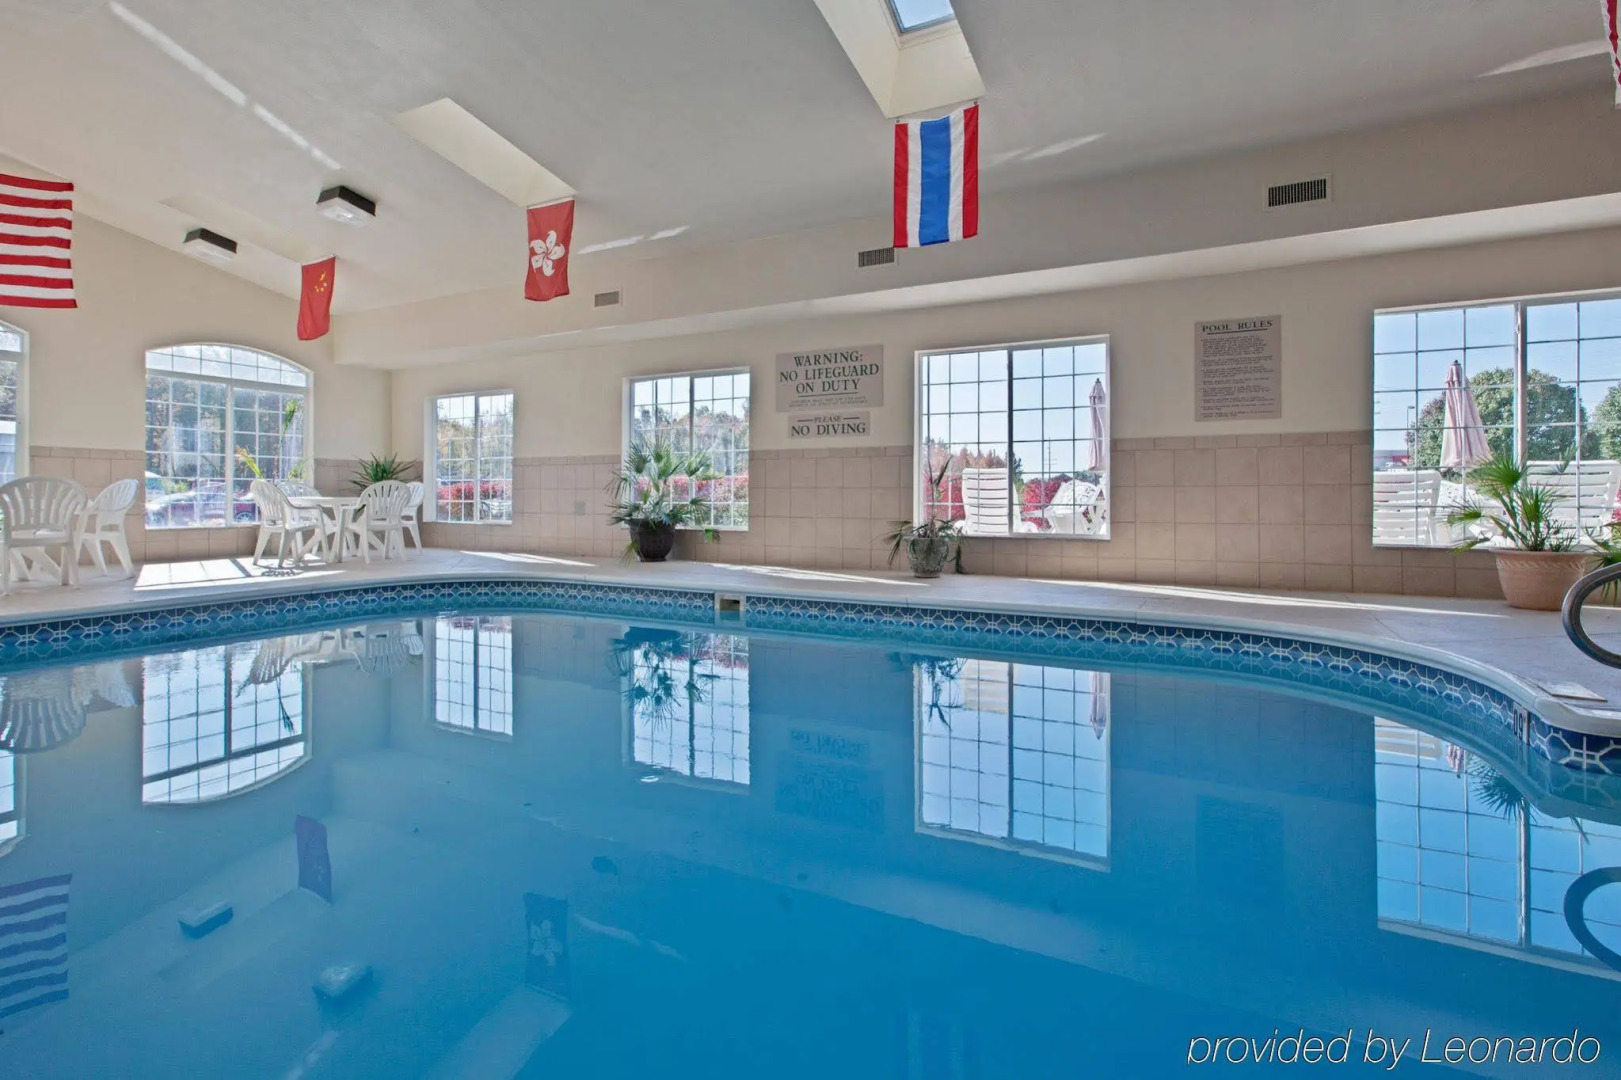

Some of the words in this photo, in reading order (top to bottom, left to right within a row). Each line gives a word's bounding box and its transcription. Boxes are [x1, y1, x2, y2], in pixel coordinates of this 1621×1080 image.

[1202, 324, 1231, 332] POOL
[1238, 320, 1272, 329] RULES
[794, 350, 863, 367] WARNING:
[780, 370, 798, 382] NO
[805, 363, 879, 380] LIFEGUARD
[796, 382, 814, 394] ON
[822, 378, 860, 392] DUTY
[814, 415, 841, 423] PLEASE
[791, 425, 810, 436] NO
[817, 423, 866, 435] DIVING
